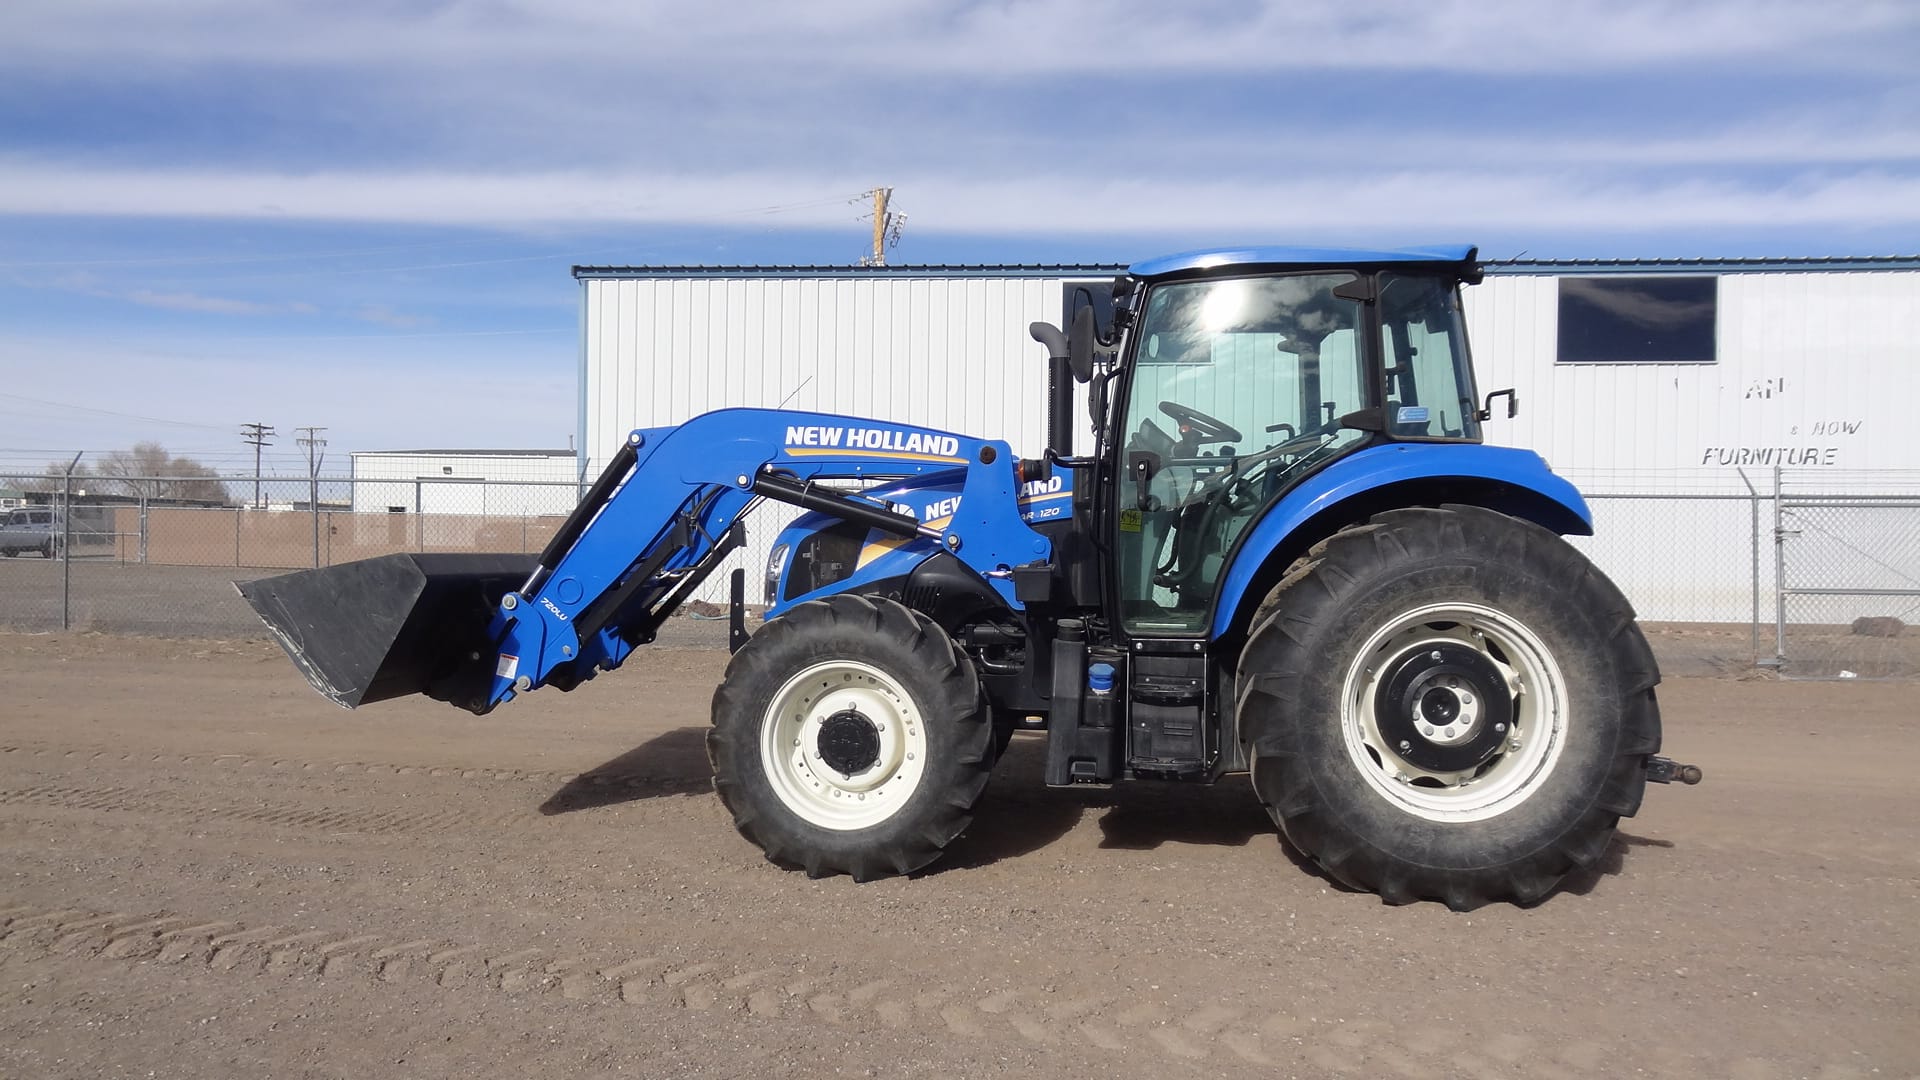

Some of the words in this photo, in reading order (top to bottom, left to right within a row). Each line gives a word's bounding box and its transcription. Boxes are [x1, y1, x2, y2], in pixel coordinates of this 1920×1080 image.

[785, 426, 843, 446] NEW
[846, 428, 959, 456] HOLLAND
[1702, 447, 1838, 465] FURNITURE
[1040, 507, 1060, 518] 120
[540, 597, 568, 621] 720LU
